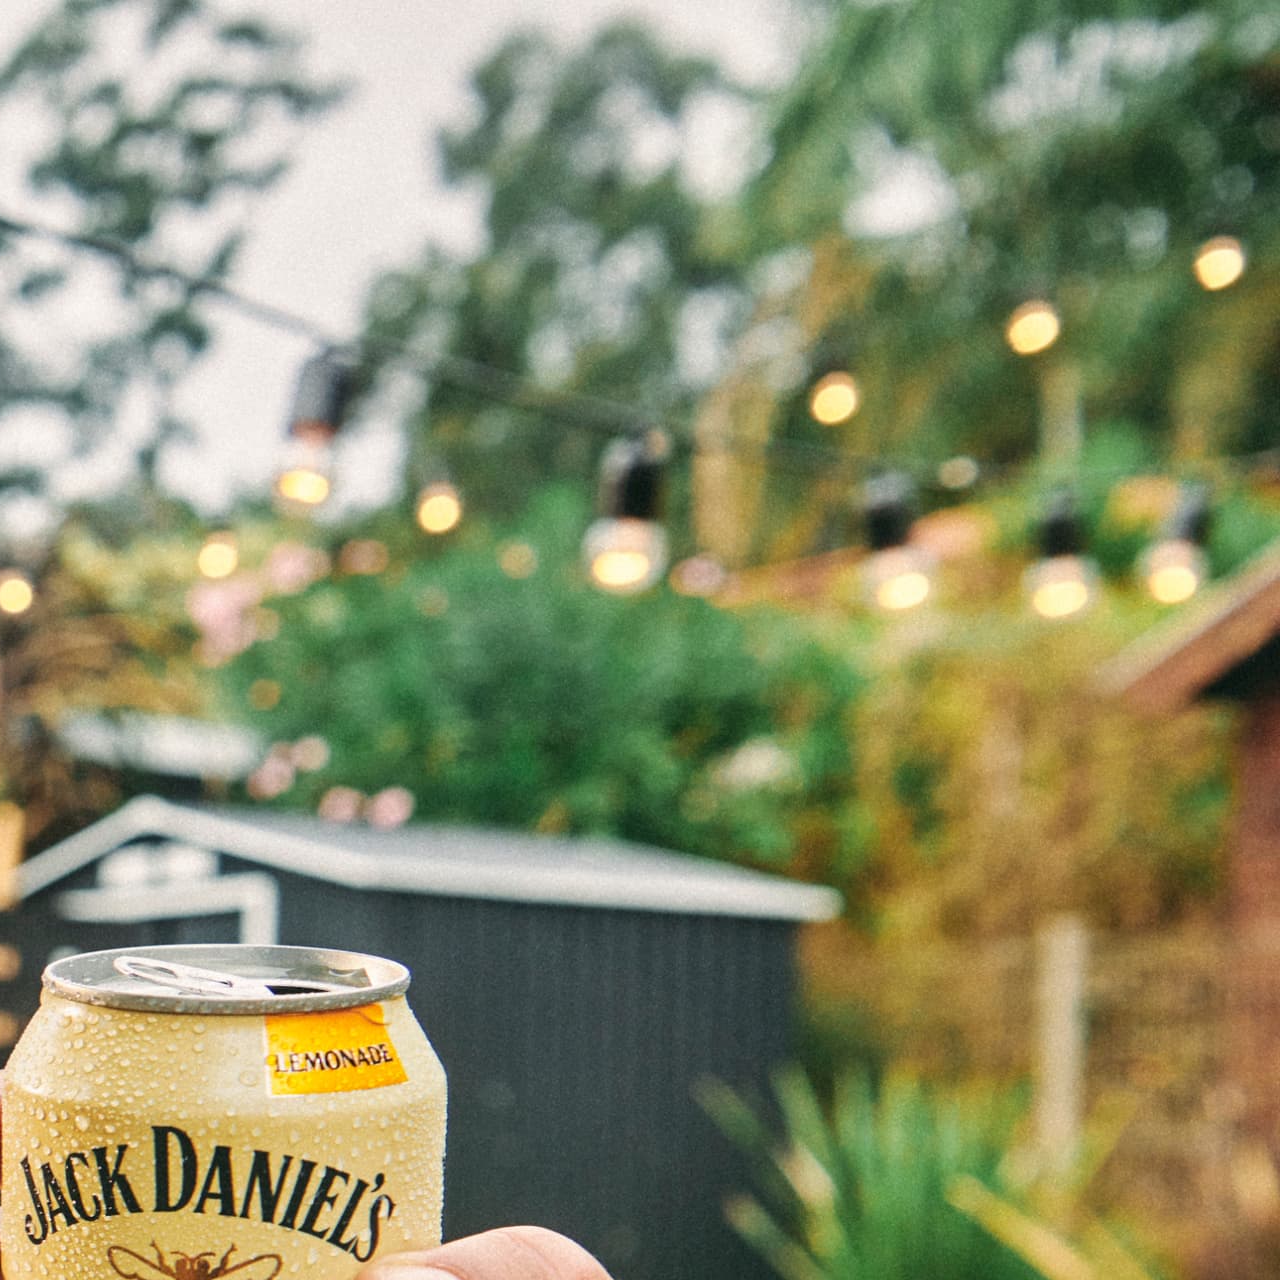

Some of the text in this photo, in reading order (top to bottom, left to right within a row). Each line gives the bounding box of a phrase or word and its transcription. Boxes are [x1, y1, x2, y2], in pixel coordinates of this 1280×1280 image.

[275, 1043, 393, 1073] LEMONADE
[21, 1125, 396, 1263] JACK DANIEL'S
